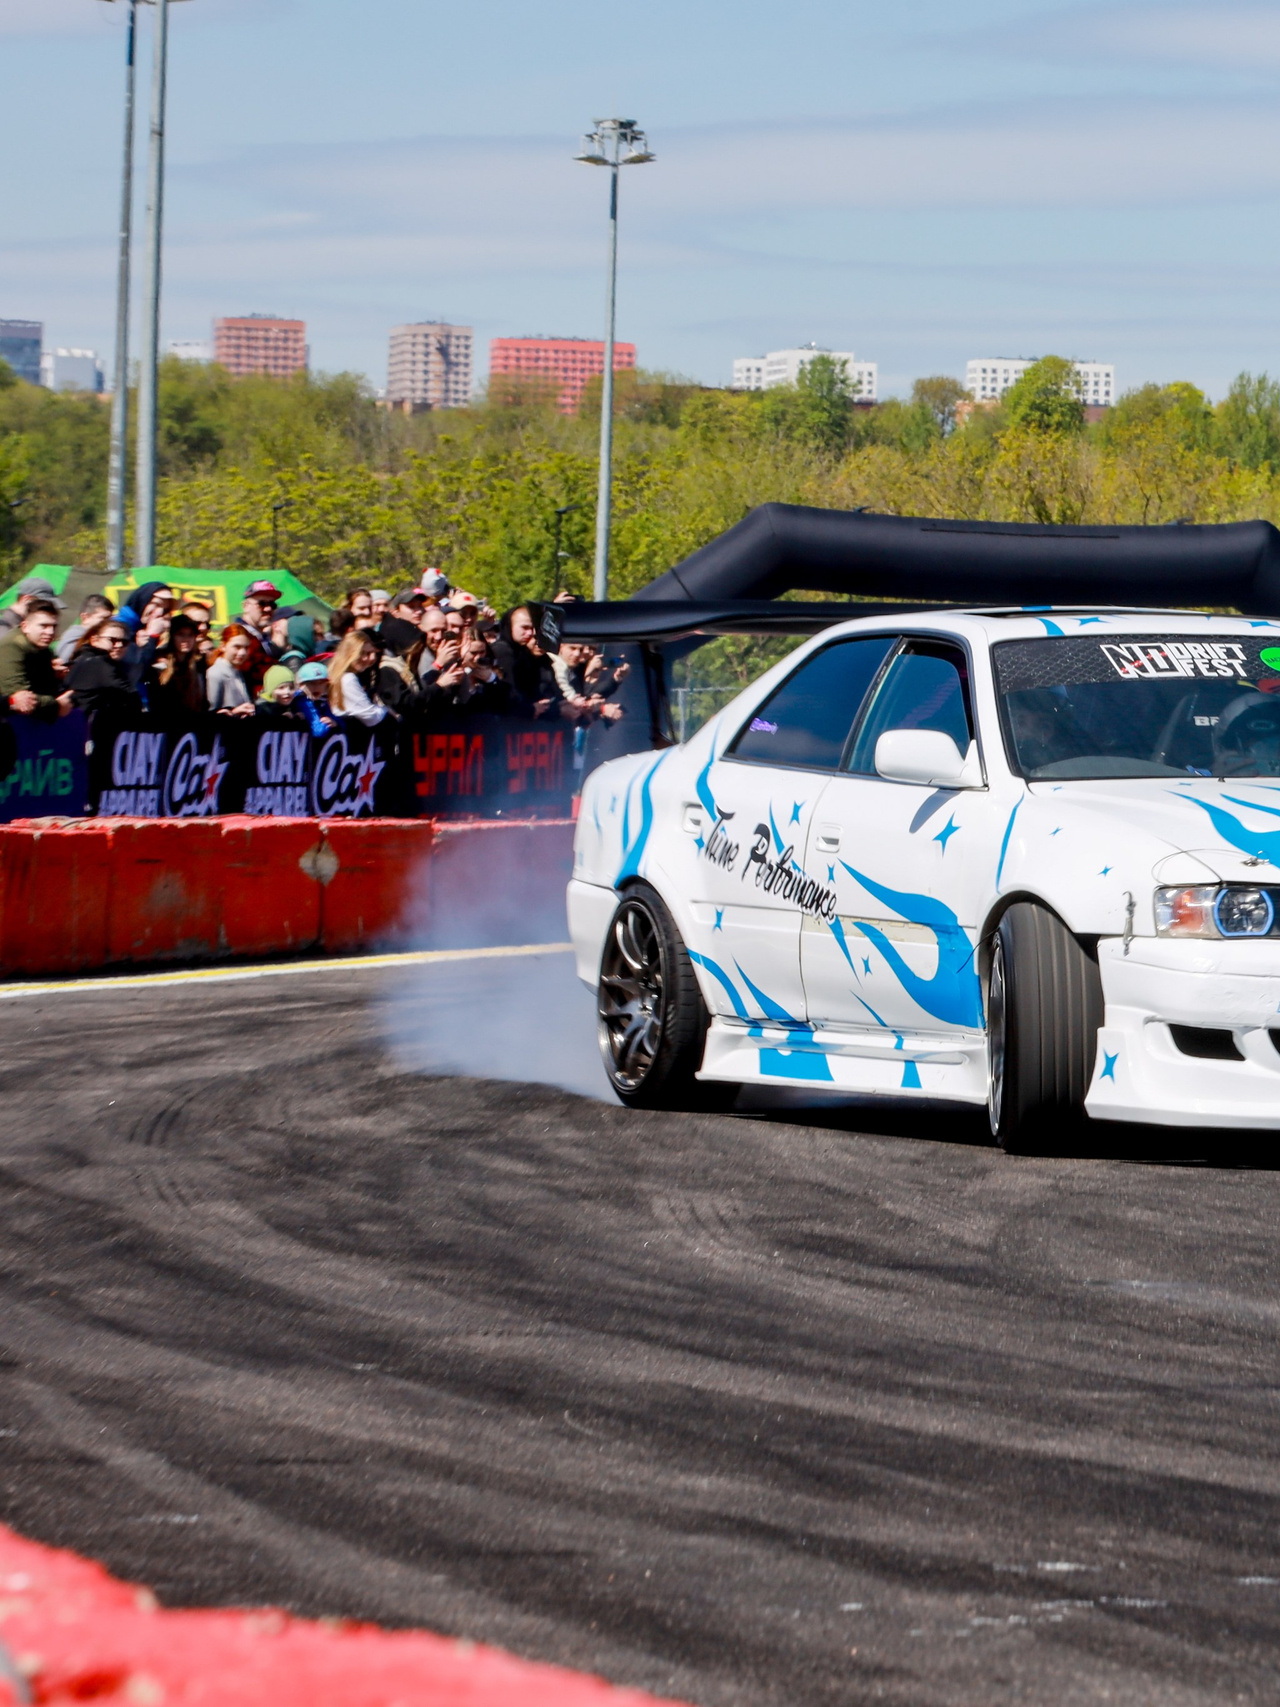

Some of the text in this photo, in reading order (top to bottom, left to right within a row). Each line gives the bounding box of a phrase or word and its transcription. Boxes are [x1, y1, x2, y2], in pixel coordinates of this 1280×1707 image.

[1166, 643, 1247, 660] DRIFT
[1178, 659, 1247, 677] FEST
[705, 804, 837, 921] Tune Performance
